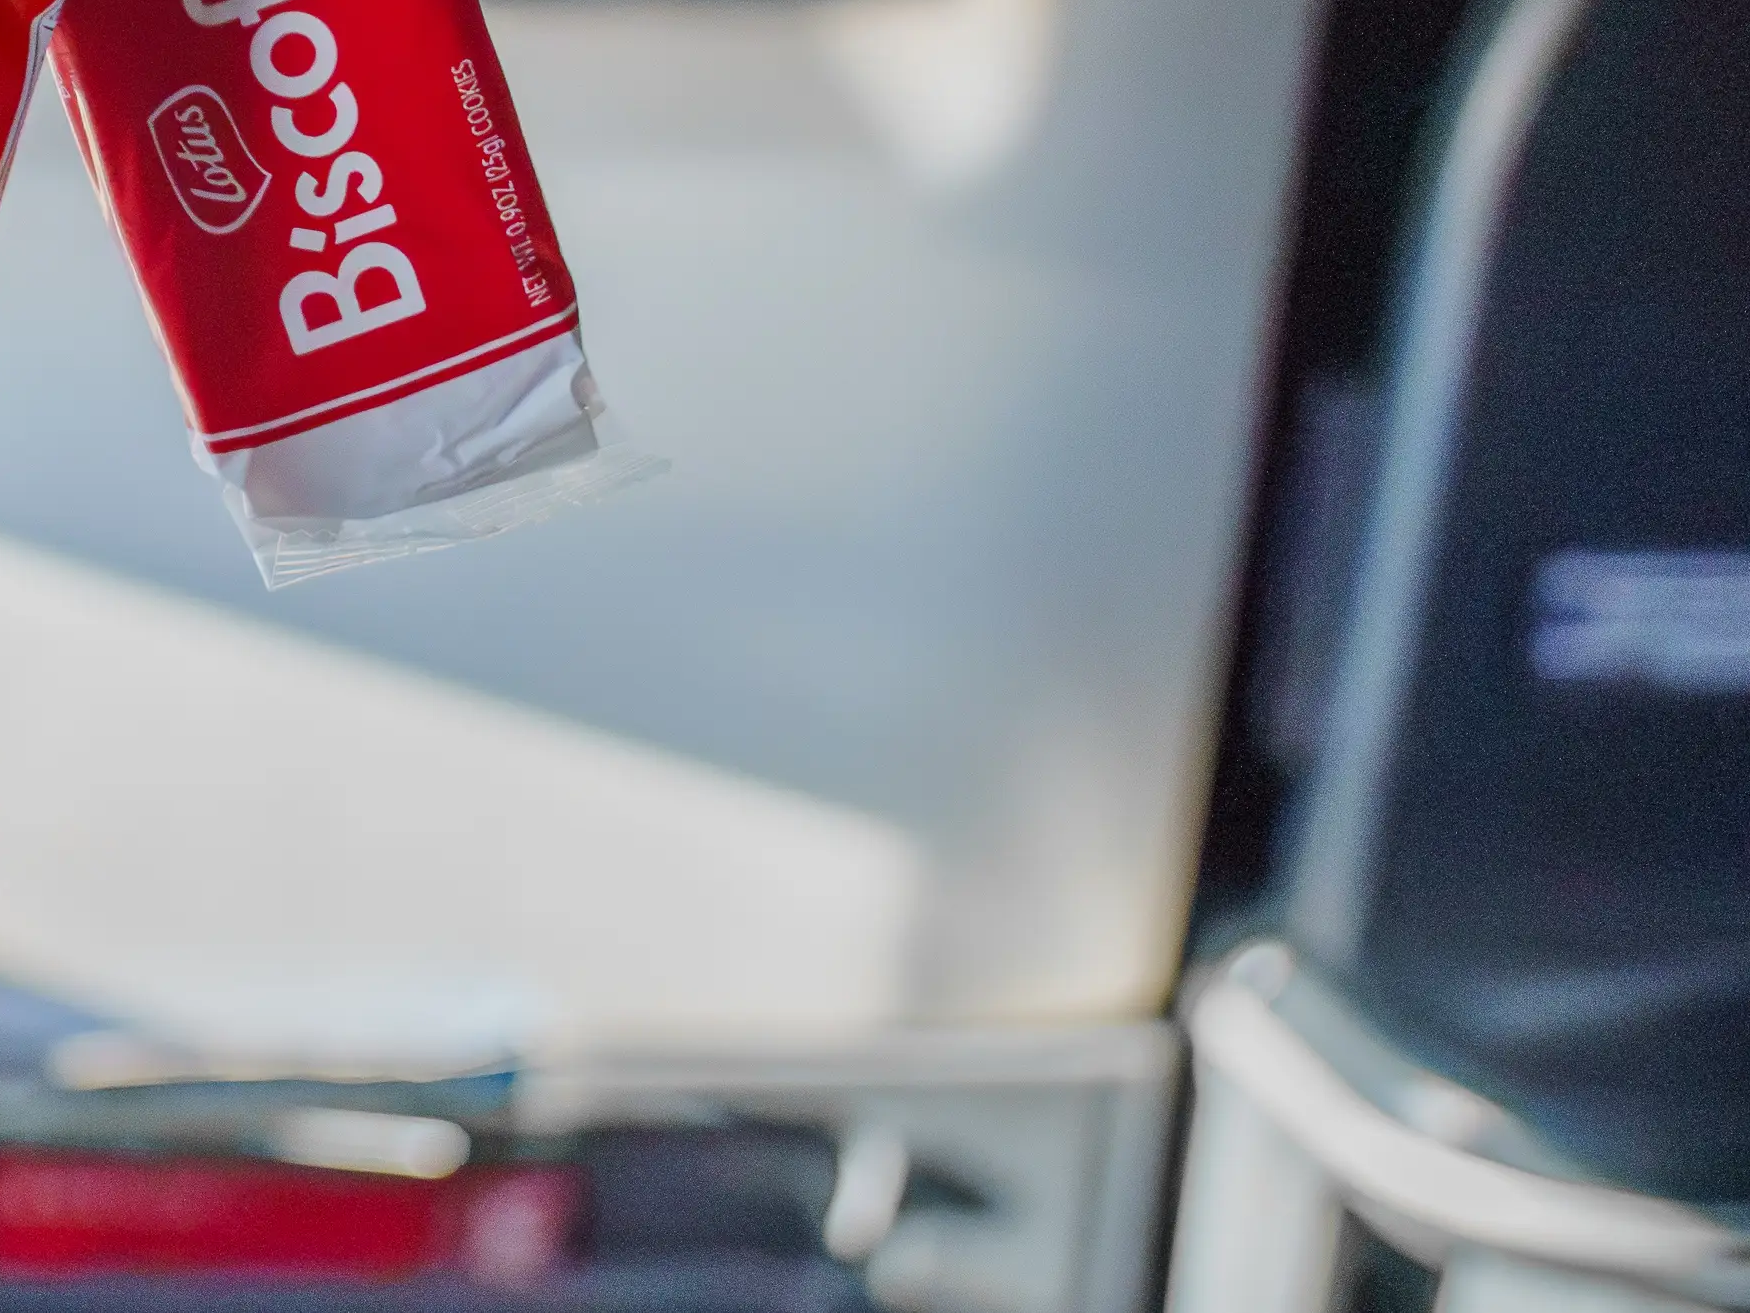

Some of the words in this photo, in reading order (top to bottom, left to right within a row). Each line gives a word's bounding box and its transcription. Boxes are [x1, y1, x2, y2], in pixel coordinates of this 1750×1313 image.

[450, 58, 494, 137] COOKIES
[173, 103, 249, 204] Lotus
[521, 271, 552, 308] NET
